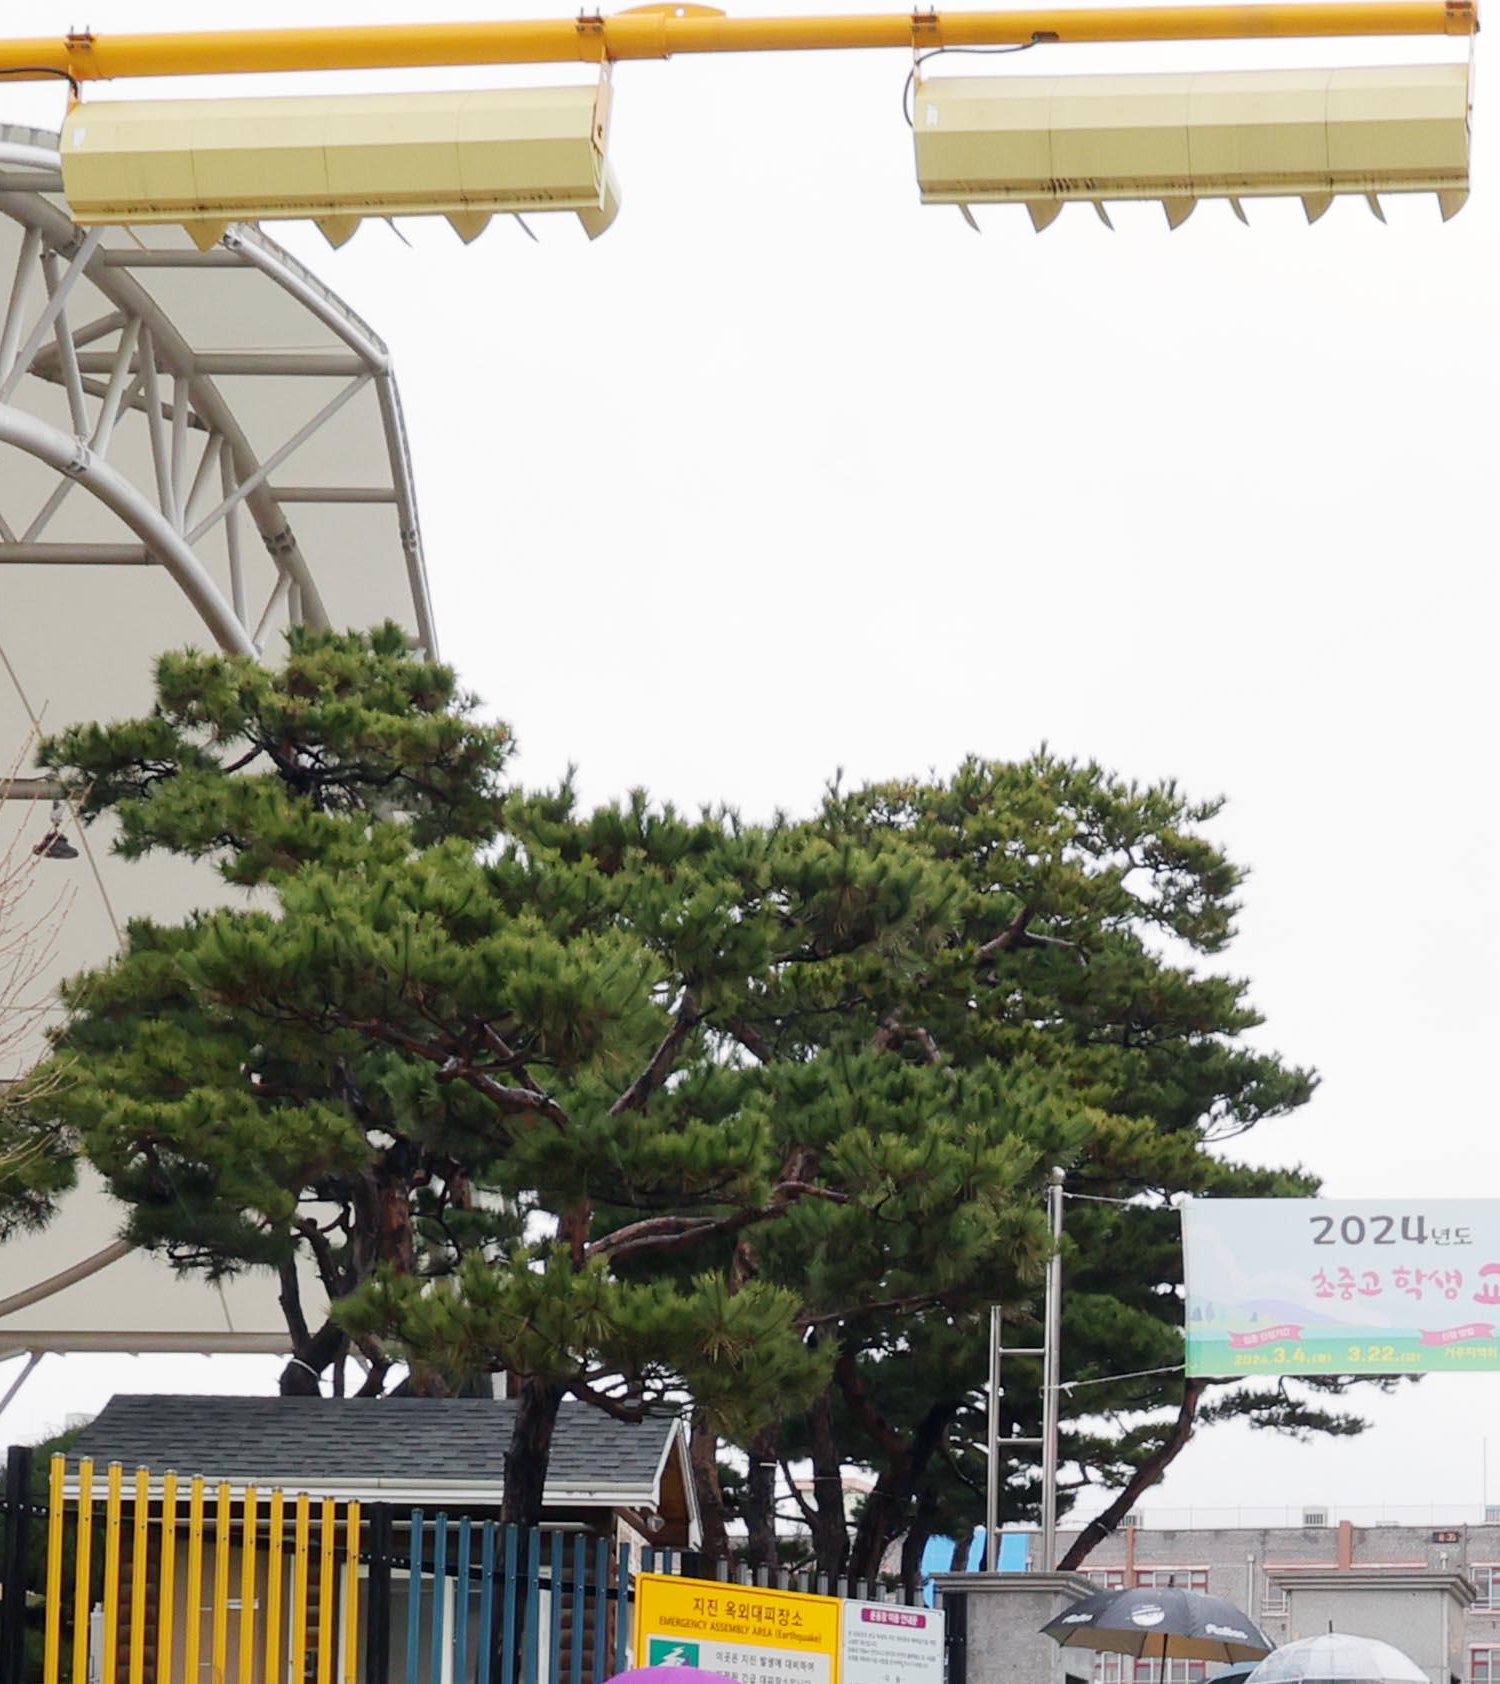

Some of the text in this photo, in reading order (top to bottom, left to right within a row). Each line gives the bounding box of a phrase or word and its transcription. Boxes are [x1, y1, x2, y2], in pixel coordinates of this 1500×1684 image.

[1309, 1214, 1473, 1246] 2024년도
[1311, 1265, 1383, 1300] 초중고
[1393, 1264, 1463, 1300] 학생
[659, 1615, 707, 1631] EMERGENCY
[710, 1620, 750, 1635] ASSEMBLY
[752, 1625, 773, 1637] AREA
[693, 1597, 804, 1627] 지진 옥외대피장소
[741, 1653, 757, 1665] 지진
[785, 1659, 815, 1672] 대비하여
